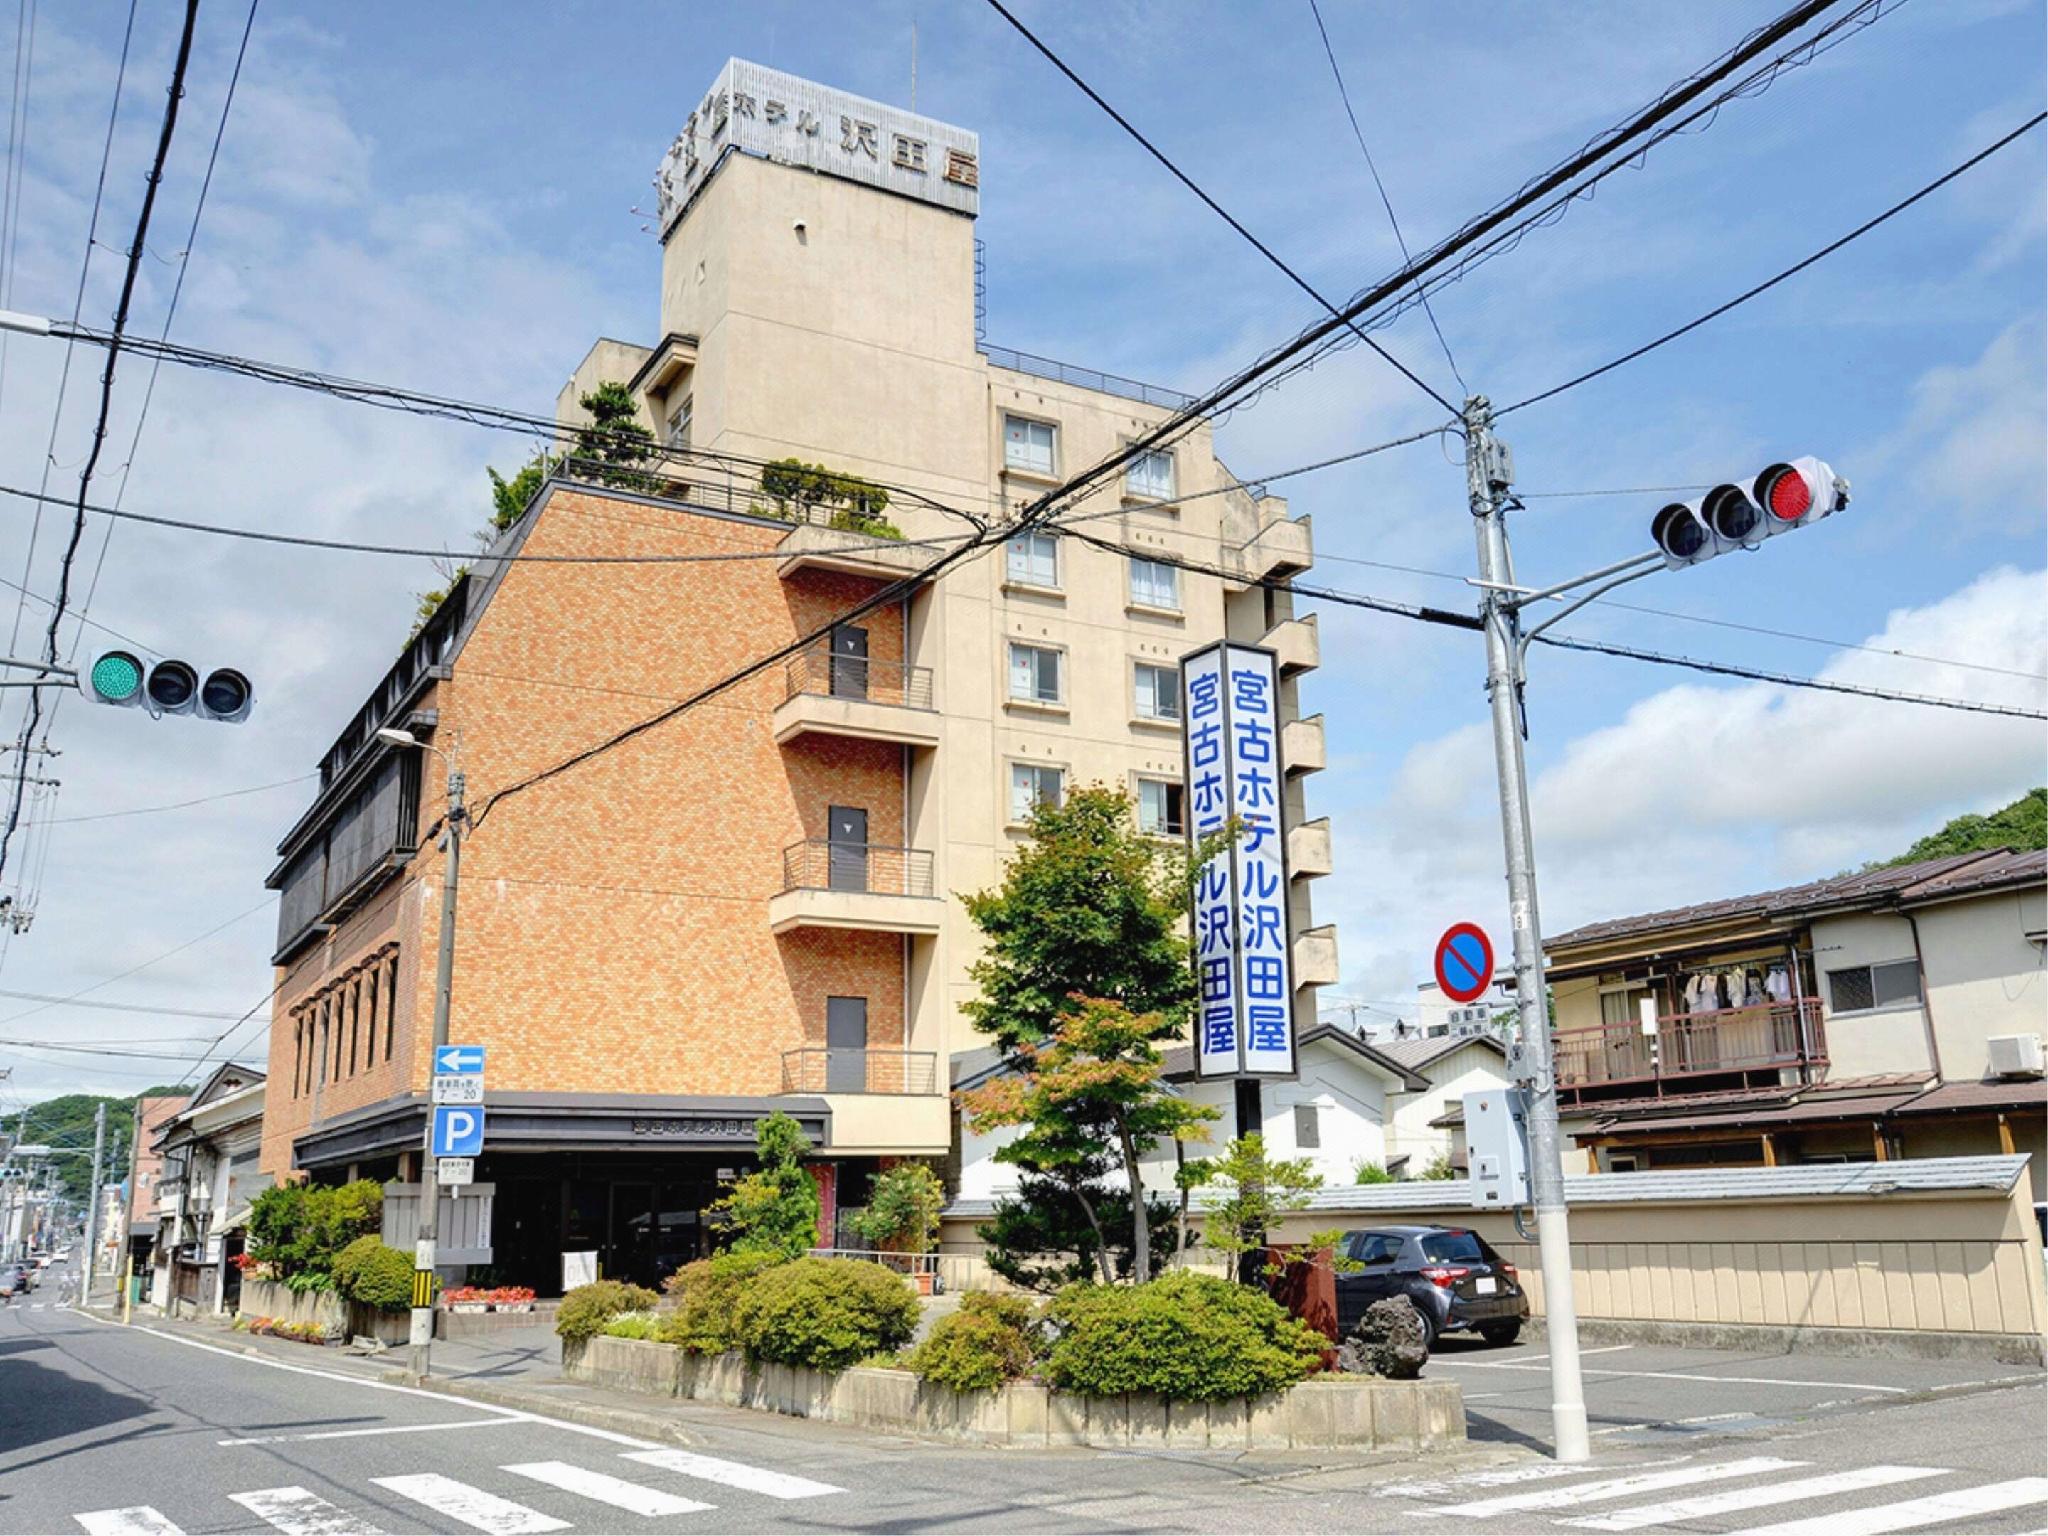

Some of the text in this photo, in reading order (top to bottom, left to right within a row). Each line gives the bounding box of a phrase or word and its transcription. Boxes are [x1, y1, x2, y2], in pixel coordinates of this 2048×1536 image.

[1231, 669, 1287, 1052] 宮古ホテル沢田屋
[445, 1111, 475, 1152] P
